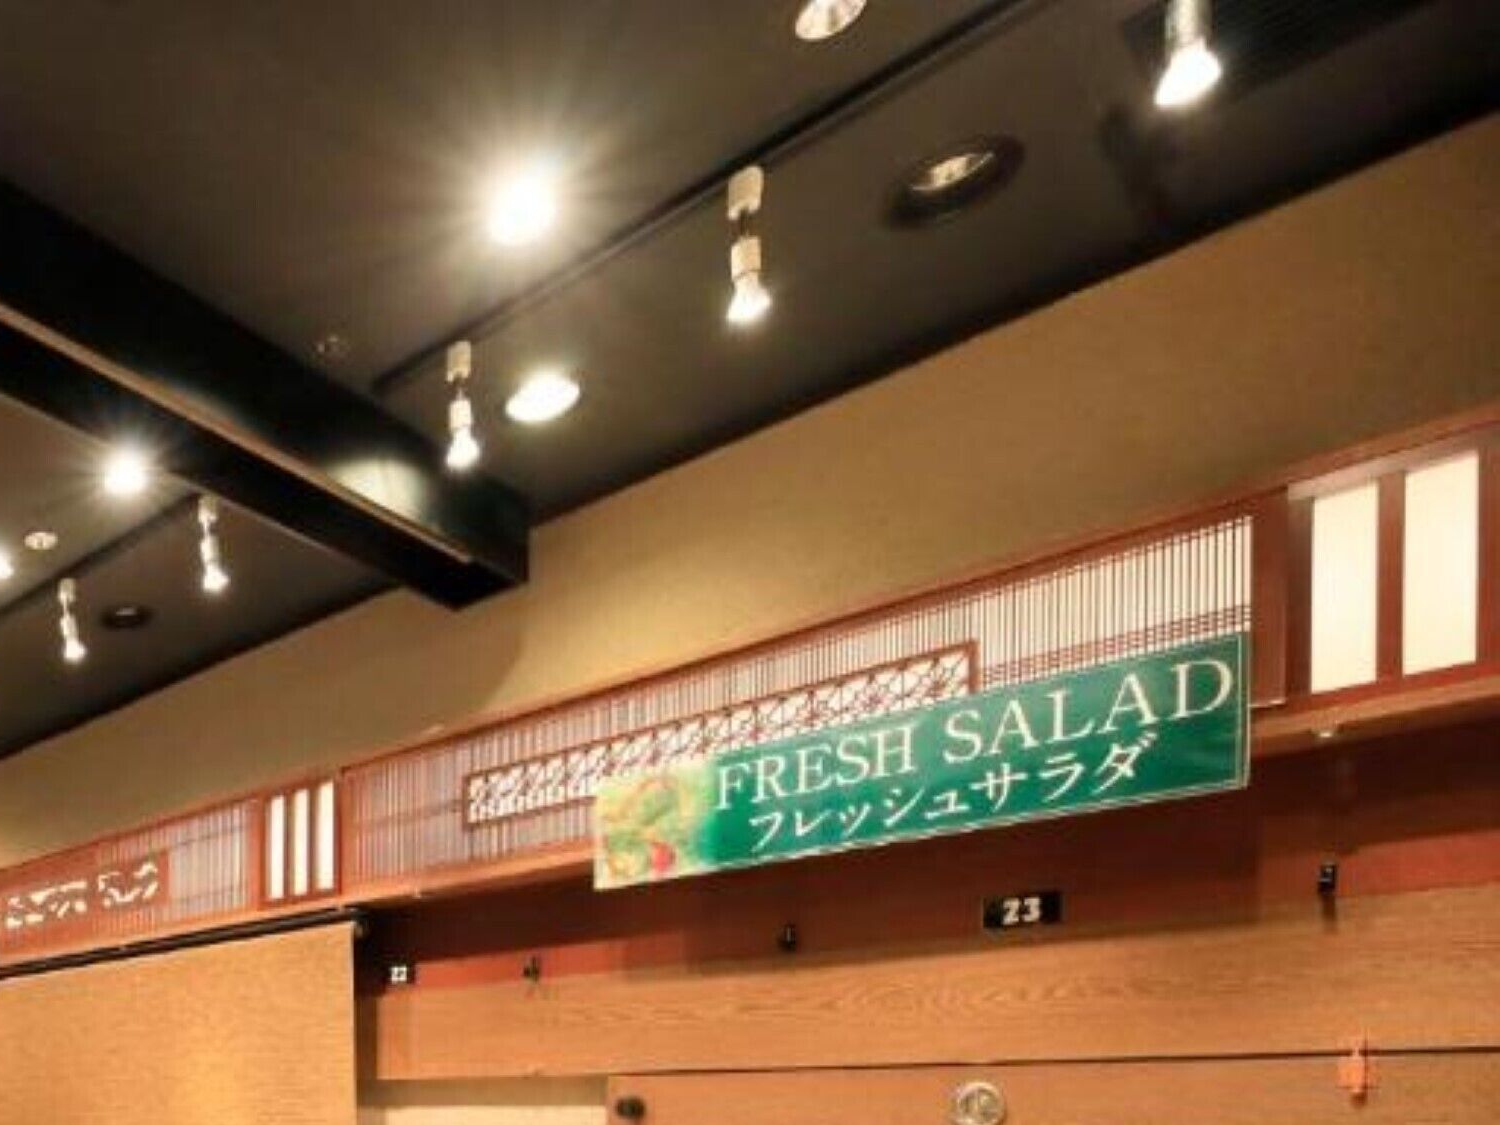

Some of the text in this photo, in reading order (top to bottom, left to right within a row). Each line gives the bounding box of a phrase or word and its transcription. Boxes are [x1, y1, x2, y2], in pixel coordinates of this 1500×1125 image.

[715, 657, 1233, 811] FRESH SALAD
[748, 731, 1157, 851] フレッシュサラダ
[1002, 896, 1041, 926] 23
